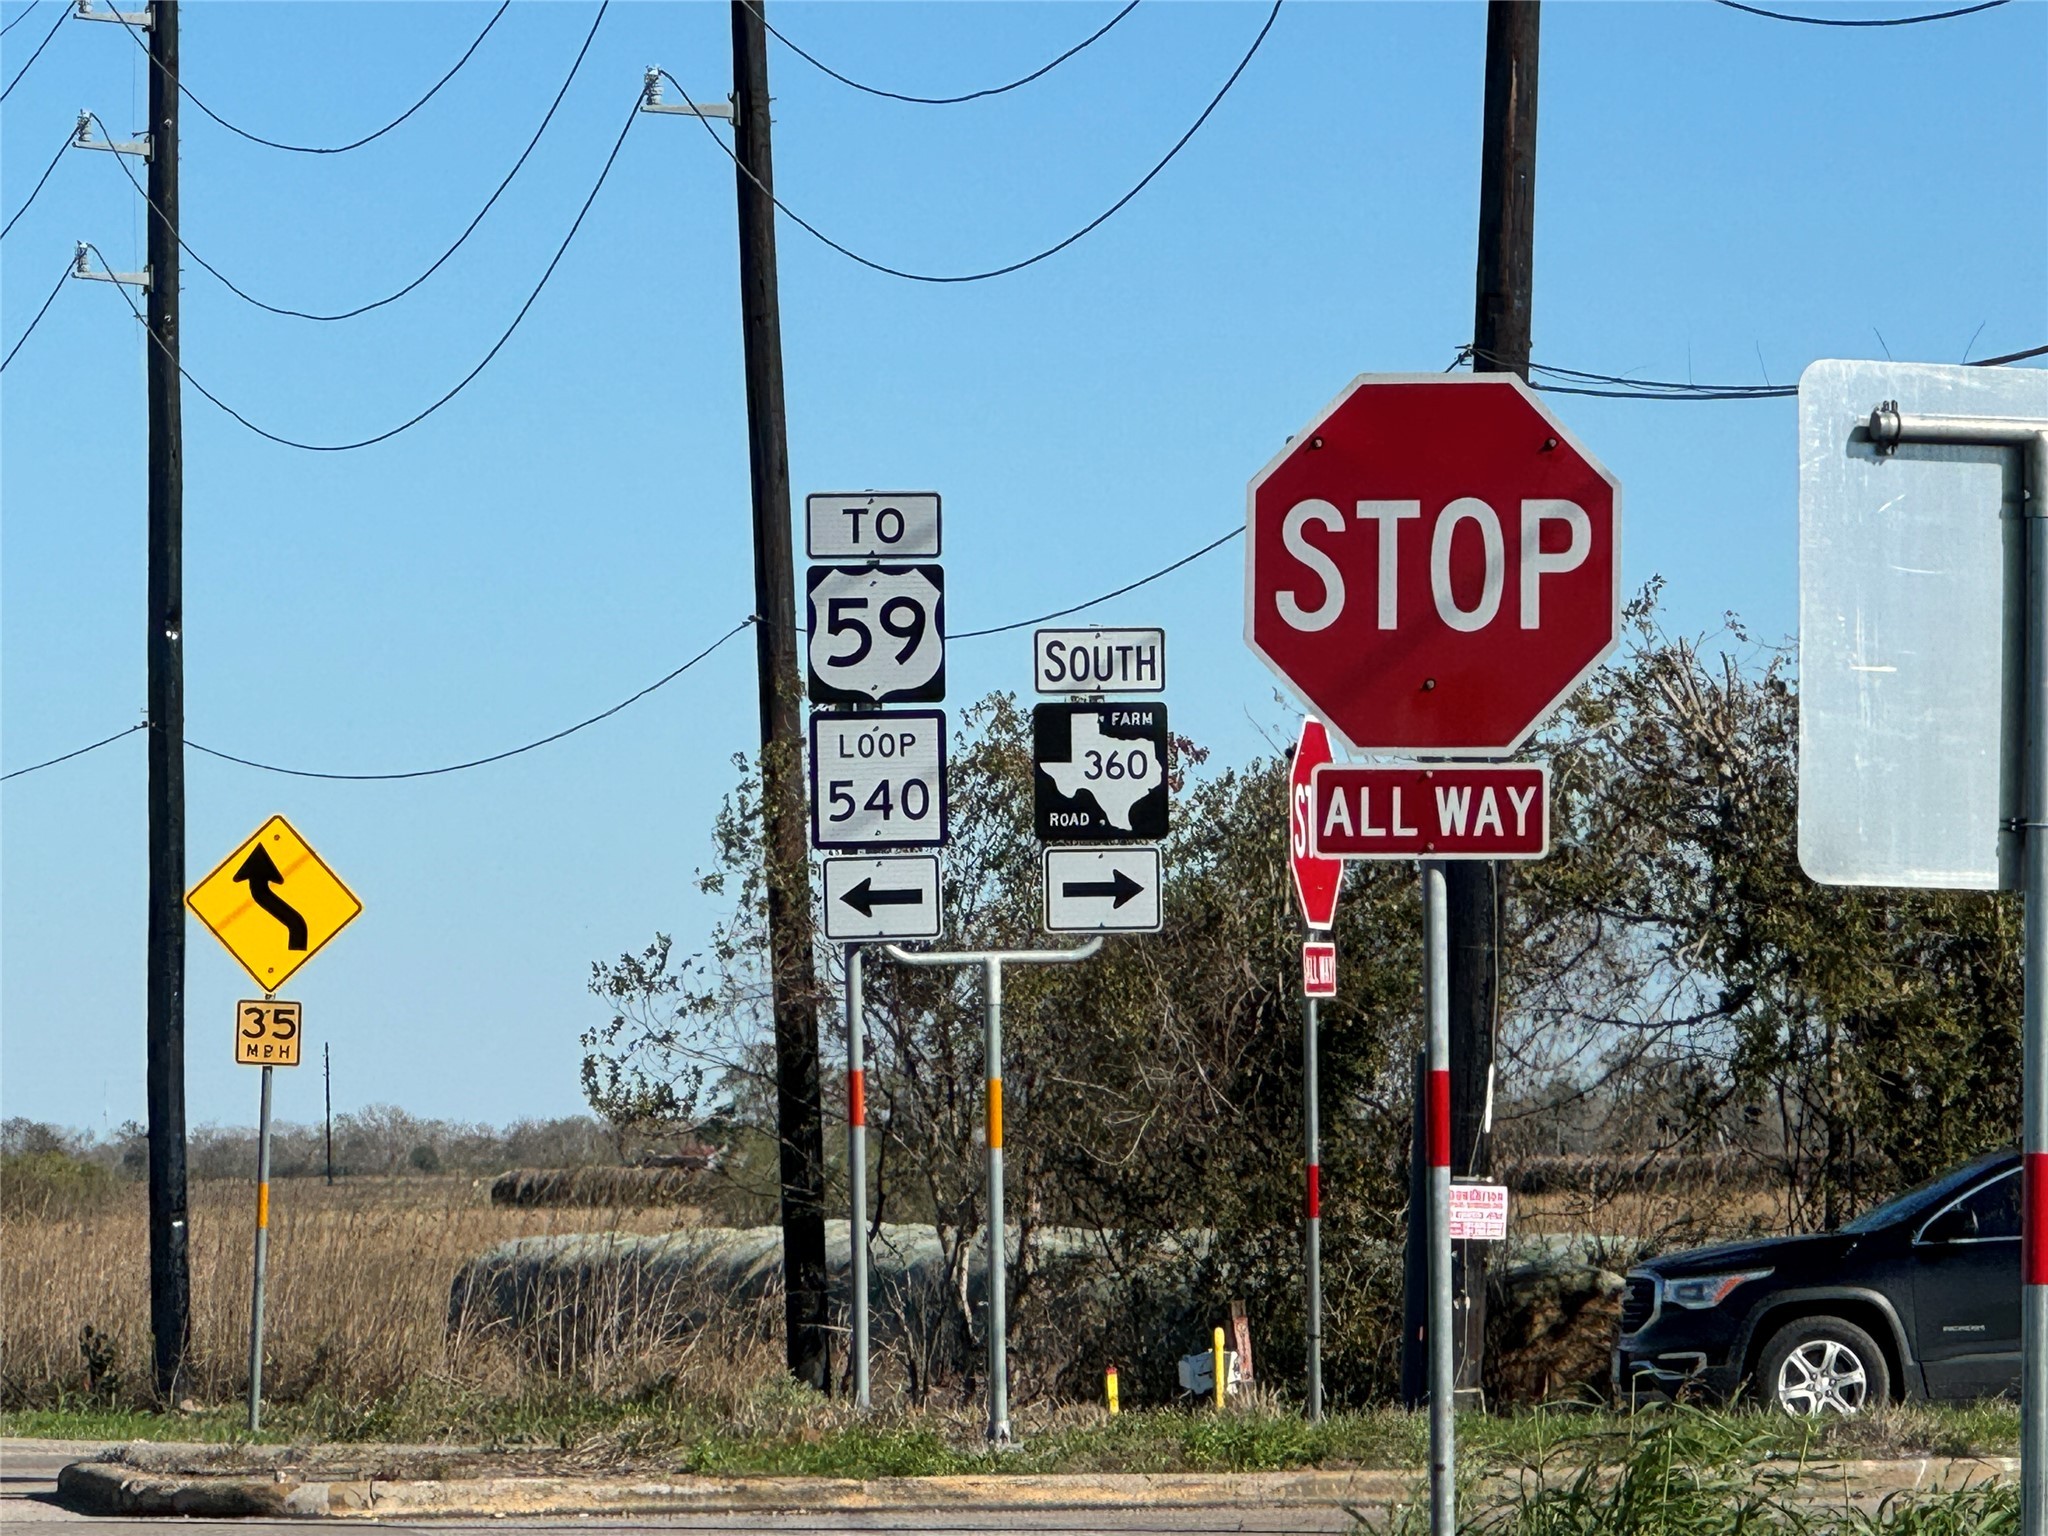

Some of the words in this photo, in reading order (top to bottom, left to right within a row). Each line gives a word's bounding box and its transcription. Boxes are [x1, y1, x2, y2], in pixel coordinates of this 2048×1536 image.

[842, 507, 906, 544] TO
[1275, 497, 1592, 632] STOP
[826, 596, 927, 668] 59
[1043, 639, 1157, 682] SOUTH
[1111, 711, 1153, 727] FARM
[838, 733, 917, 759] LOOP
[1084, 749, 1148, 780] 360
[829, 777, 930, 822] 540
[1322, 786, 1419, 837] ALL
[1435, 786, 1537, 837] WAY
[1050, 812, 1090, 827] ROAD
[1294, 783, 1314, 859] ST
[242, 1007, 296, 1040] 35
[246, 1043, 290, 1059] MPH
